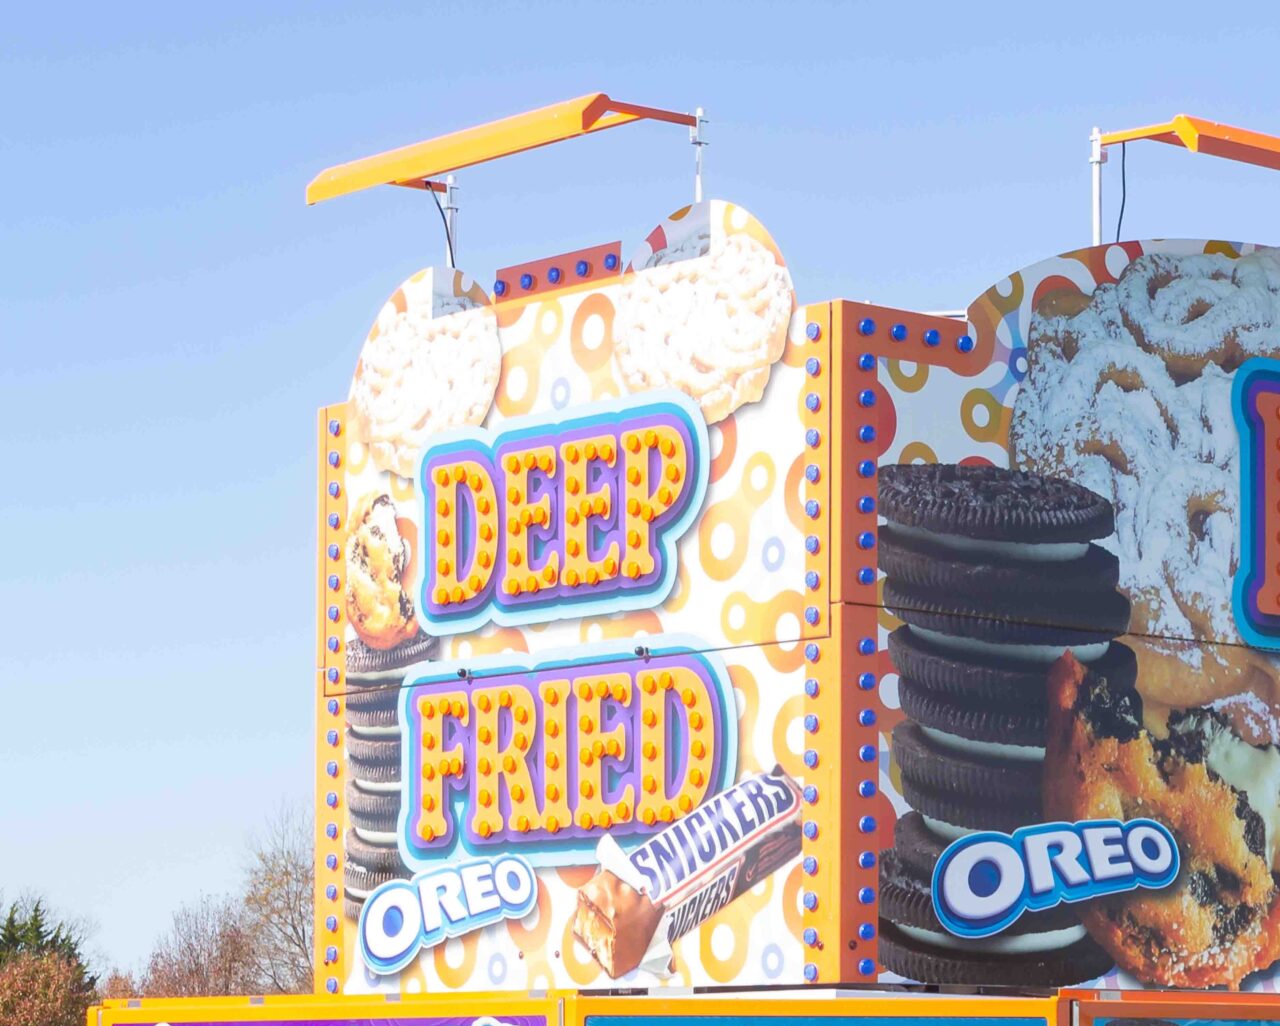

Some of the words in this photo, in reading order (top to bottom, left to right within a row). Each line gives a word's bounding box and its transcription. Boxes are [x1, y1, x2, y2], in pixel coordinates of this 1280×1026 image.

[431, 425, 687, 605] DEEP
[417, 668, 715, 841] FRIED
[629, 774, 794, 900] SNICKERS
[944, 831, 1172, 918] OREO
[366, 861, 531, 959] OREO
[667, 866, 738, 944] NICKERS
